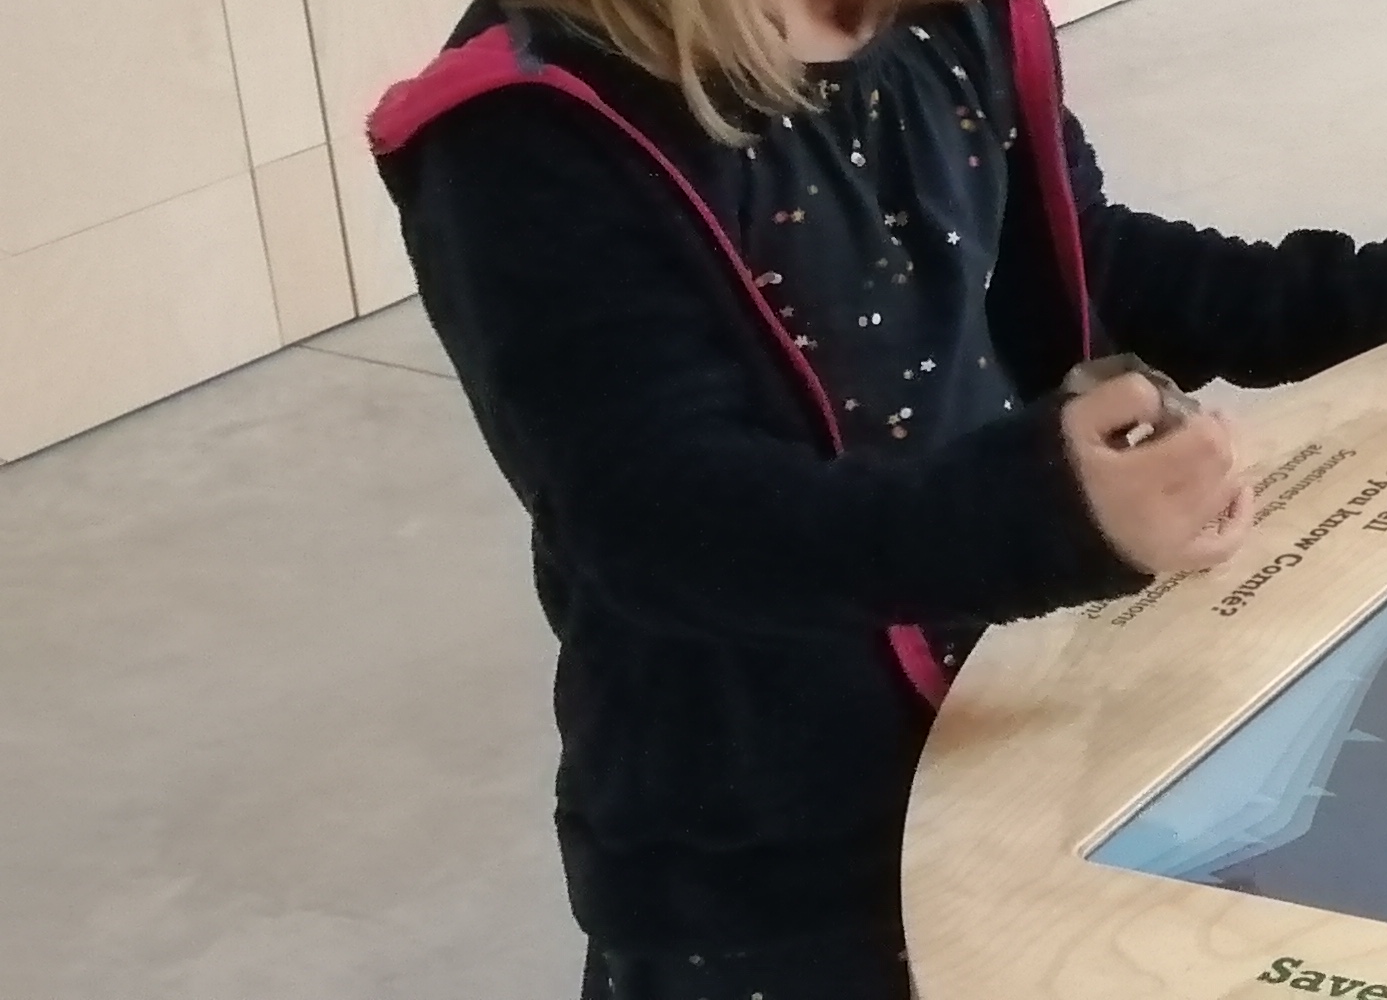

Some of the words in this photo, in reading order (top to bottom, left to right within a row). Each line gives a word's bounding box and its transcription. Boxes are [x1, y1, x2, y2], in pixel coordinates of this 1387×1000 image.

[1279, 444, 1322, 472] about
[1279, 449, 1357, 500] Sometimes
[1296, 508, 1362, 551] know
[1211, 553, 1303, 617] Comté?
